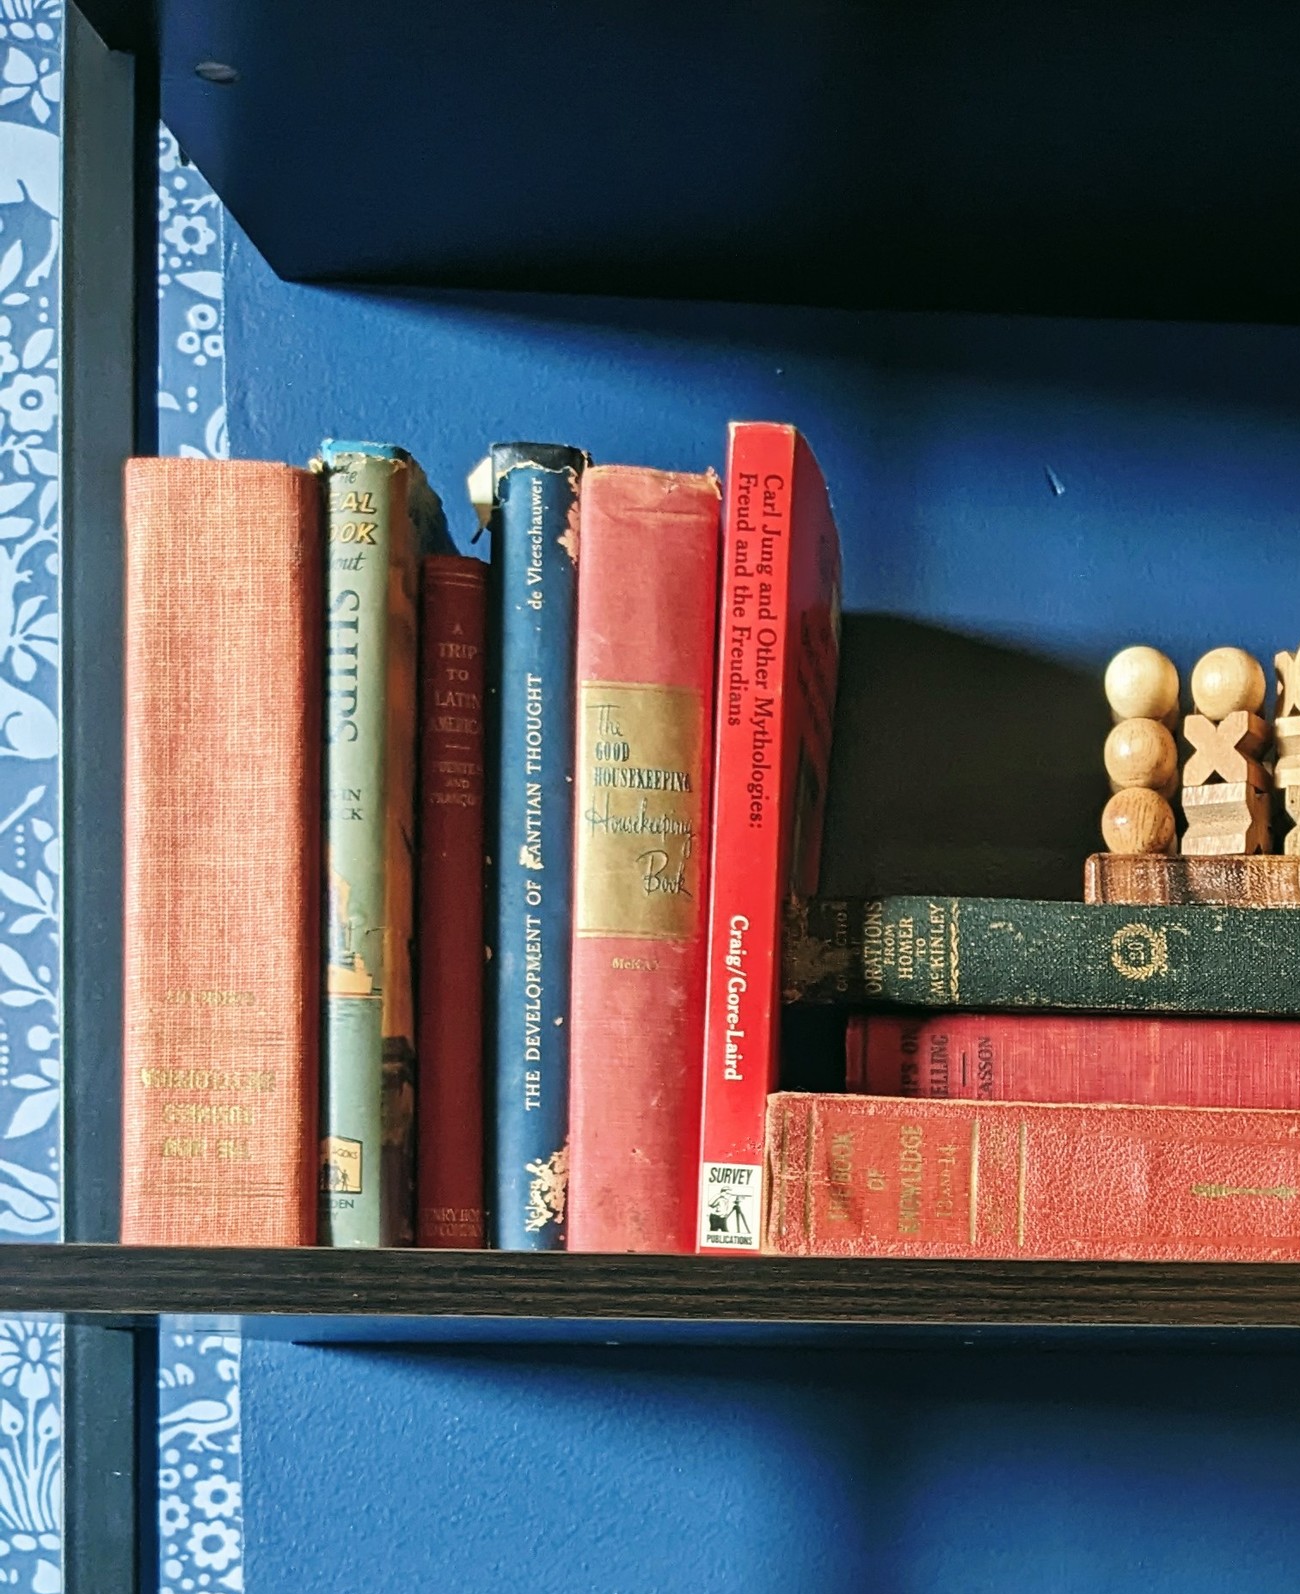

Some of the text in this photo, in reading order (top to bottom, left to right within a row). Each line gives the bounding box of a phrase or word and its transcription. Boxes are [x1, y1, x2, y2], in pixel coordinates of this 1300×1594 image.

[329, 491, 377, 513] EAL
[526, 477, 543, 610] de Vleeschauwer
[728, 473, 759, 727] Freud and the Freudians
[438, 643, 477, 659] TRIP
[748, 473, 786, 829] Carl Jung and Other Mythologies:
[446, 668, 469, 681] TO
[526, 672, 542, 774] THOUGHT
[586, 704, 623, 738] The
[595, 741, 631, 762] GOOD
[585, 793, 696, 858] Housekeeping
[525, 878, 542, 905] OF
[636, 850, 693, 898] Book
[864, 901, 883, 994] ORATIONS
[884, 923, 896, 966] FROM
[898, 916, 914, 980] HOMER
[915, 937, 927, 959] TO
[525, 915, 543, 1062] DEVELOPMENT
[929, 1034, 949, 1097] ELLING
[525, 1069, 541, 1111] THE
[708, 1166, 754, 1186] SURVEY
[831, 1131, 854, 1182] BOOK
[866, 1168, 886, 1191] OF
[898, 1125, 923, 1234] KNOWLEDGE
[705, 1233, 753, 1246] PUBLICATIONS
